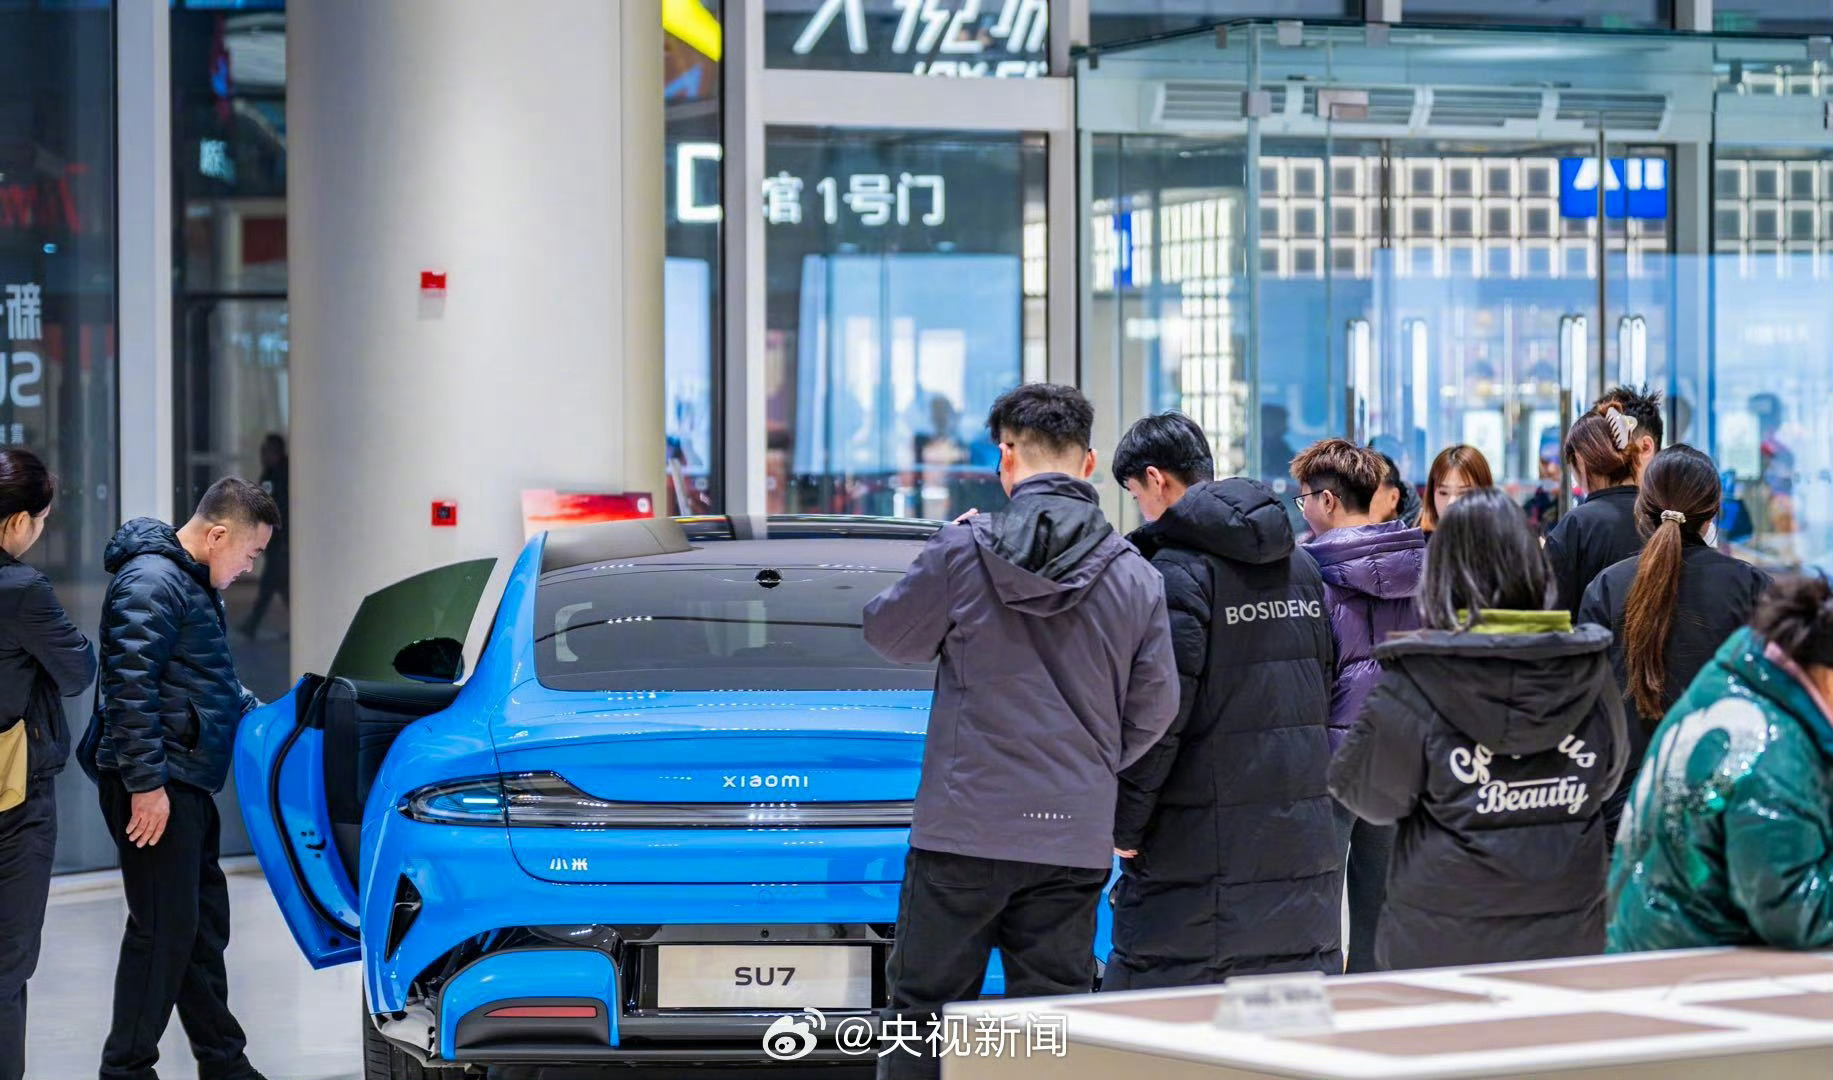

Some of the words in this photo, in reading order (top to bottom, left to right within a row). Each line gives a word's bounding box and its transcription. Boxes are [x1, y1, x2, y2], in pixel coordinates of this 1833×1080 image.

[1224, 599, 1321, 625] BOSIDENG
[721, 774, 809, 788] xiaomi
[1476, 777, 1589, 815] Beauty
[549, 857, 588, 871] 小米
[734, 966, 796, 986] SU7
